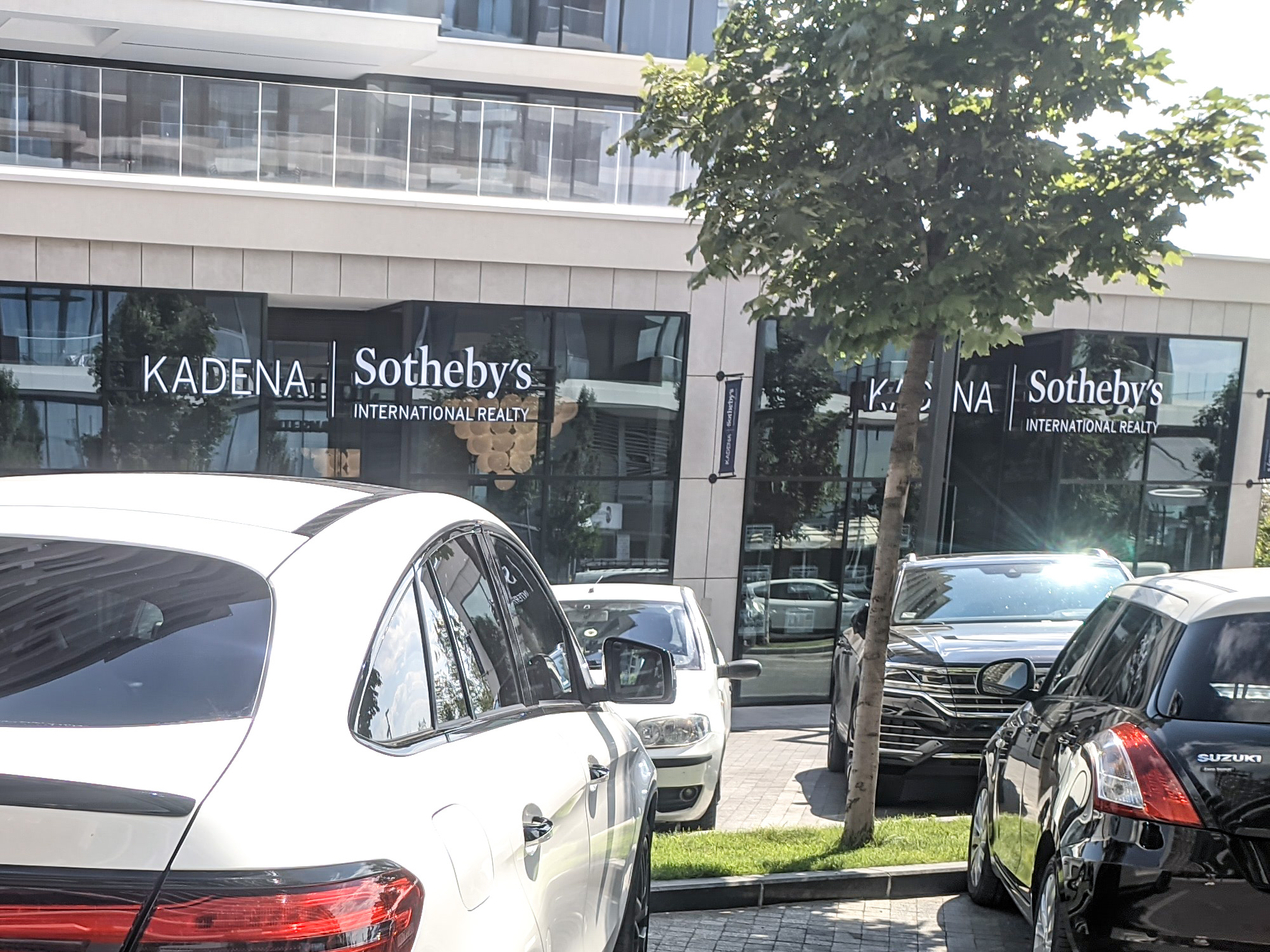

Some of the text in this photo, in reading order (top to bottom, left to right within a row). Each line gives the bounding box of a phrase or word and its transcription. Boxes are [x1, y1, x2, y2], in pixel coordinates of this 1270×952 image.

[143, 345, 533, 399] KADENA Sotheby's
[1029, 366, 1163, 415] Sotheby's
[354, 403, 530, 422] INTERNATIONAL REALTY
[1026, 418, 1159, 435] INTERNATIONAL REALTY
[1197, 753, 1263, 763] SUZUKI
